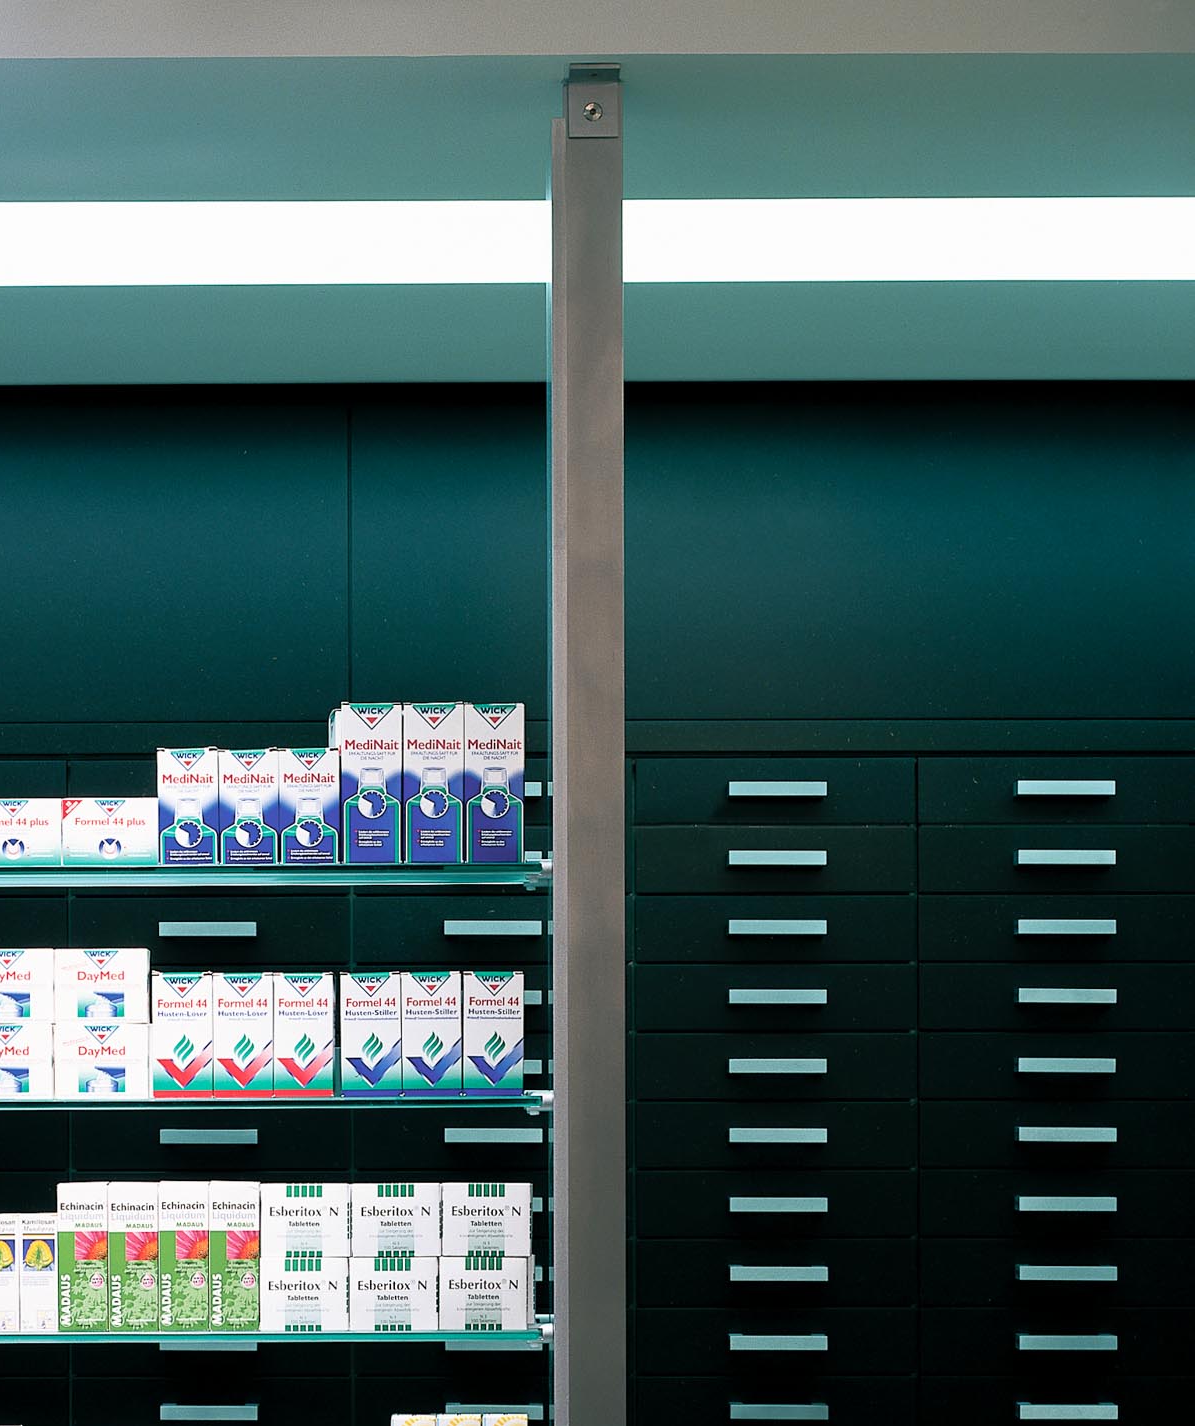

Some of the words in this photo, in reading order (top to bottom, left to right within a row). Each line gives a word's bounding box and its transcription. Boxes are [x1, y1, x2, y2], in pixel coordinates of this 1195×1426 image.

[345, 739, 399, 750] MediNait
[407, 739, 461, 750] MediNait
[468, 739, 522, 750] MediNait
[162, 774, 213, 784] MediNait
[223, 774, 274, 784] MediNait
[284, 773, 335, 784] MediNait
[75, 817, 109, 826] Formel
[114, 817, 124, 826] 44
[127, 817, 145, 827] plus
[157, 1000, 193, 1008] Formel
[196, 1000, 207, 1008] 44
[346, 998, 381, 1007] Formel
[384, 998, 396, 1007] 44
[469, 997, 505, 1007] Formel
[508, 997, 519, 1006] 44
[78, 1047, 126, 1057] DayMed
[60, 1203, 103, 1212] Echinacin
[111, 1203, 154, 1212] Echinacin
[212, 1202, 255, 1211] Echinacin
[452, 1206, 505, 1217] Esberitox
[512, 1207, 521, 1216] N
[361, 1207, 414, 1217] Esberitox
[422, 1207, 431, 1216] N
[449, 1279, 501, 1290] Esberitox
[509, 1280, 518, 1289] N
[61, 1274, 71, 1327] MADAUS
[213, 1274, 223, 1327] MADAUS
